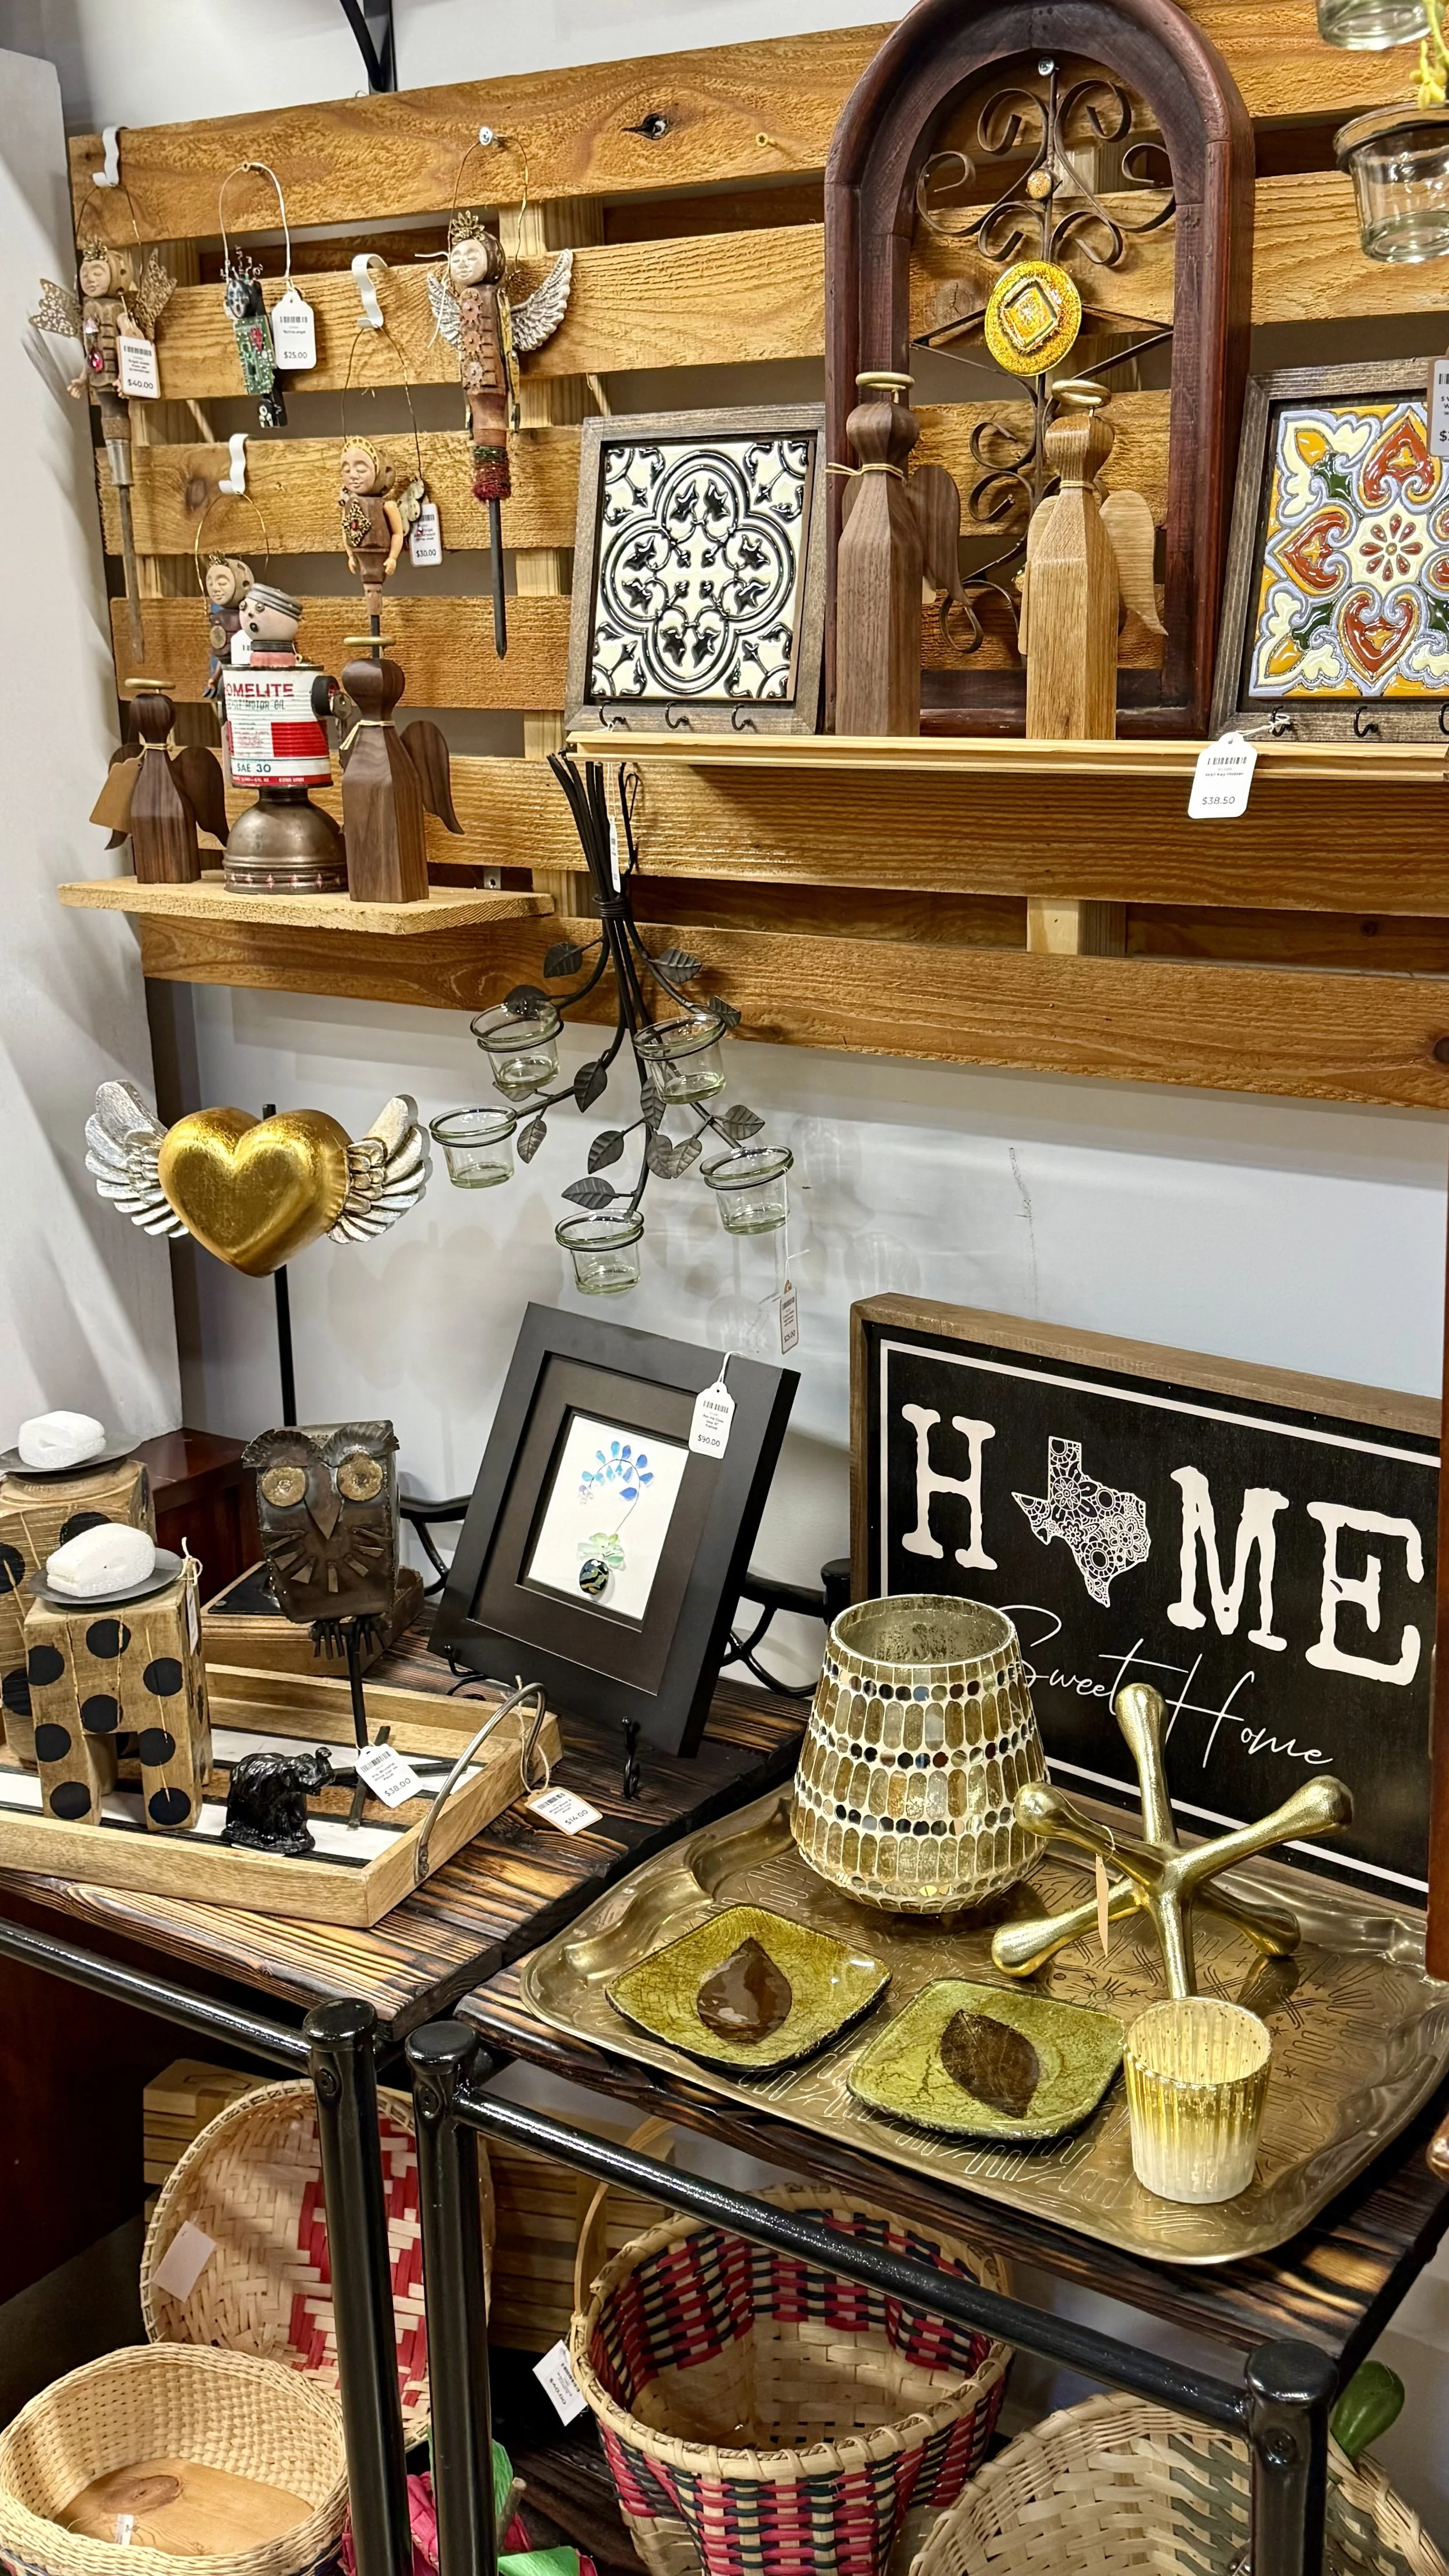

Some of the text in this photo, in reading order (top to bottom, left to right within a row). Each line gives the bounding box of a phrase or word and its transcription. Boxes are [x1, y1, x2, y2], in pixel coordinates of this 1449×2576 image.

[283, 351, 308, 359] $25.00
[128, 379, 154, 389] $40.00
[416, 549, 436, 558] $30.00
[225, 683, 294, 698] OMELITE
[237, 763, 271, 772] SAE 30
[1201, 796, 1235, 805] $38.50
[697, 1434, 720, 1447] $90.00
[1164, 1653, 1334, 1769] Home
[384, 1777, 411, 1796] $38.00
[565, 1810, 588, 1825] $14.00
